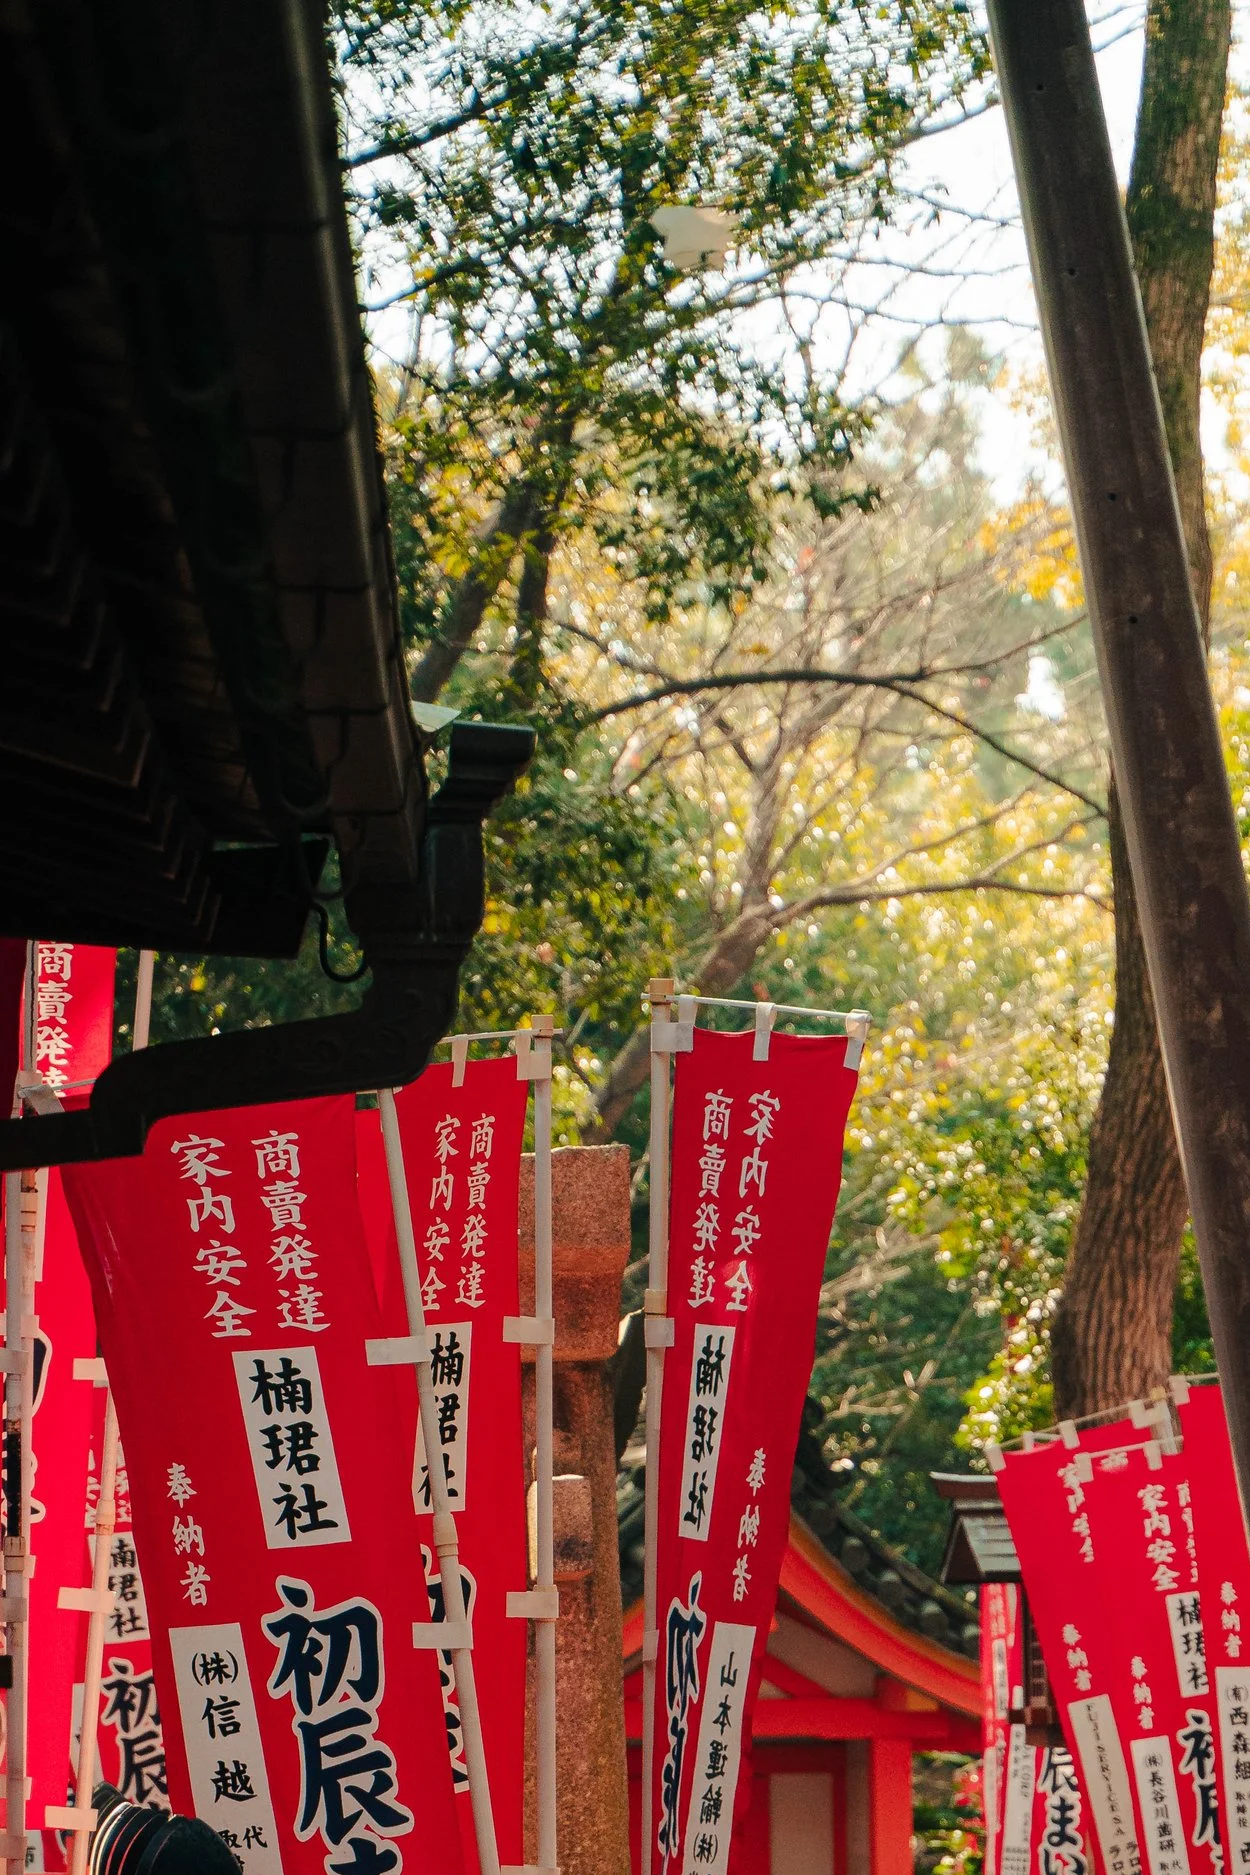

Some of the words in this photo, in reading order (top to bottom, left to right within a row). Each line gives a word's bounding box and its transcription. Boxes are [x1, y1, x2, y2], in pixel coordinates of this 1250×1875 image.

[171, 1133, 257, 1338] 家内安全
[251, 1130, 330, 1333] 商賣発達
[417, 1114, 461, 1312] 家内安全
[455, 1112, 496, 1309] 商賣発達
[248, 1356, 339, 1541] 楠珺社
[166, 1462, 211, 1606] 奉納者
[1137, 1484, 1180, 1591] 家内安全
[1063, 1624, 1092, 1691] 奉納者
[1131, 1656, 1155, 1729] 奉納者
[1221, 1581, 1242, 1658] 奉納者
[100, 1657, 170, 1816] 初辰
[191, 1649, 258, 1804] (株)信越
